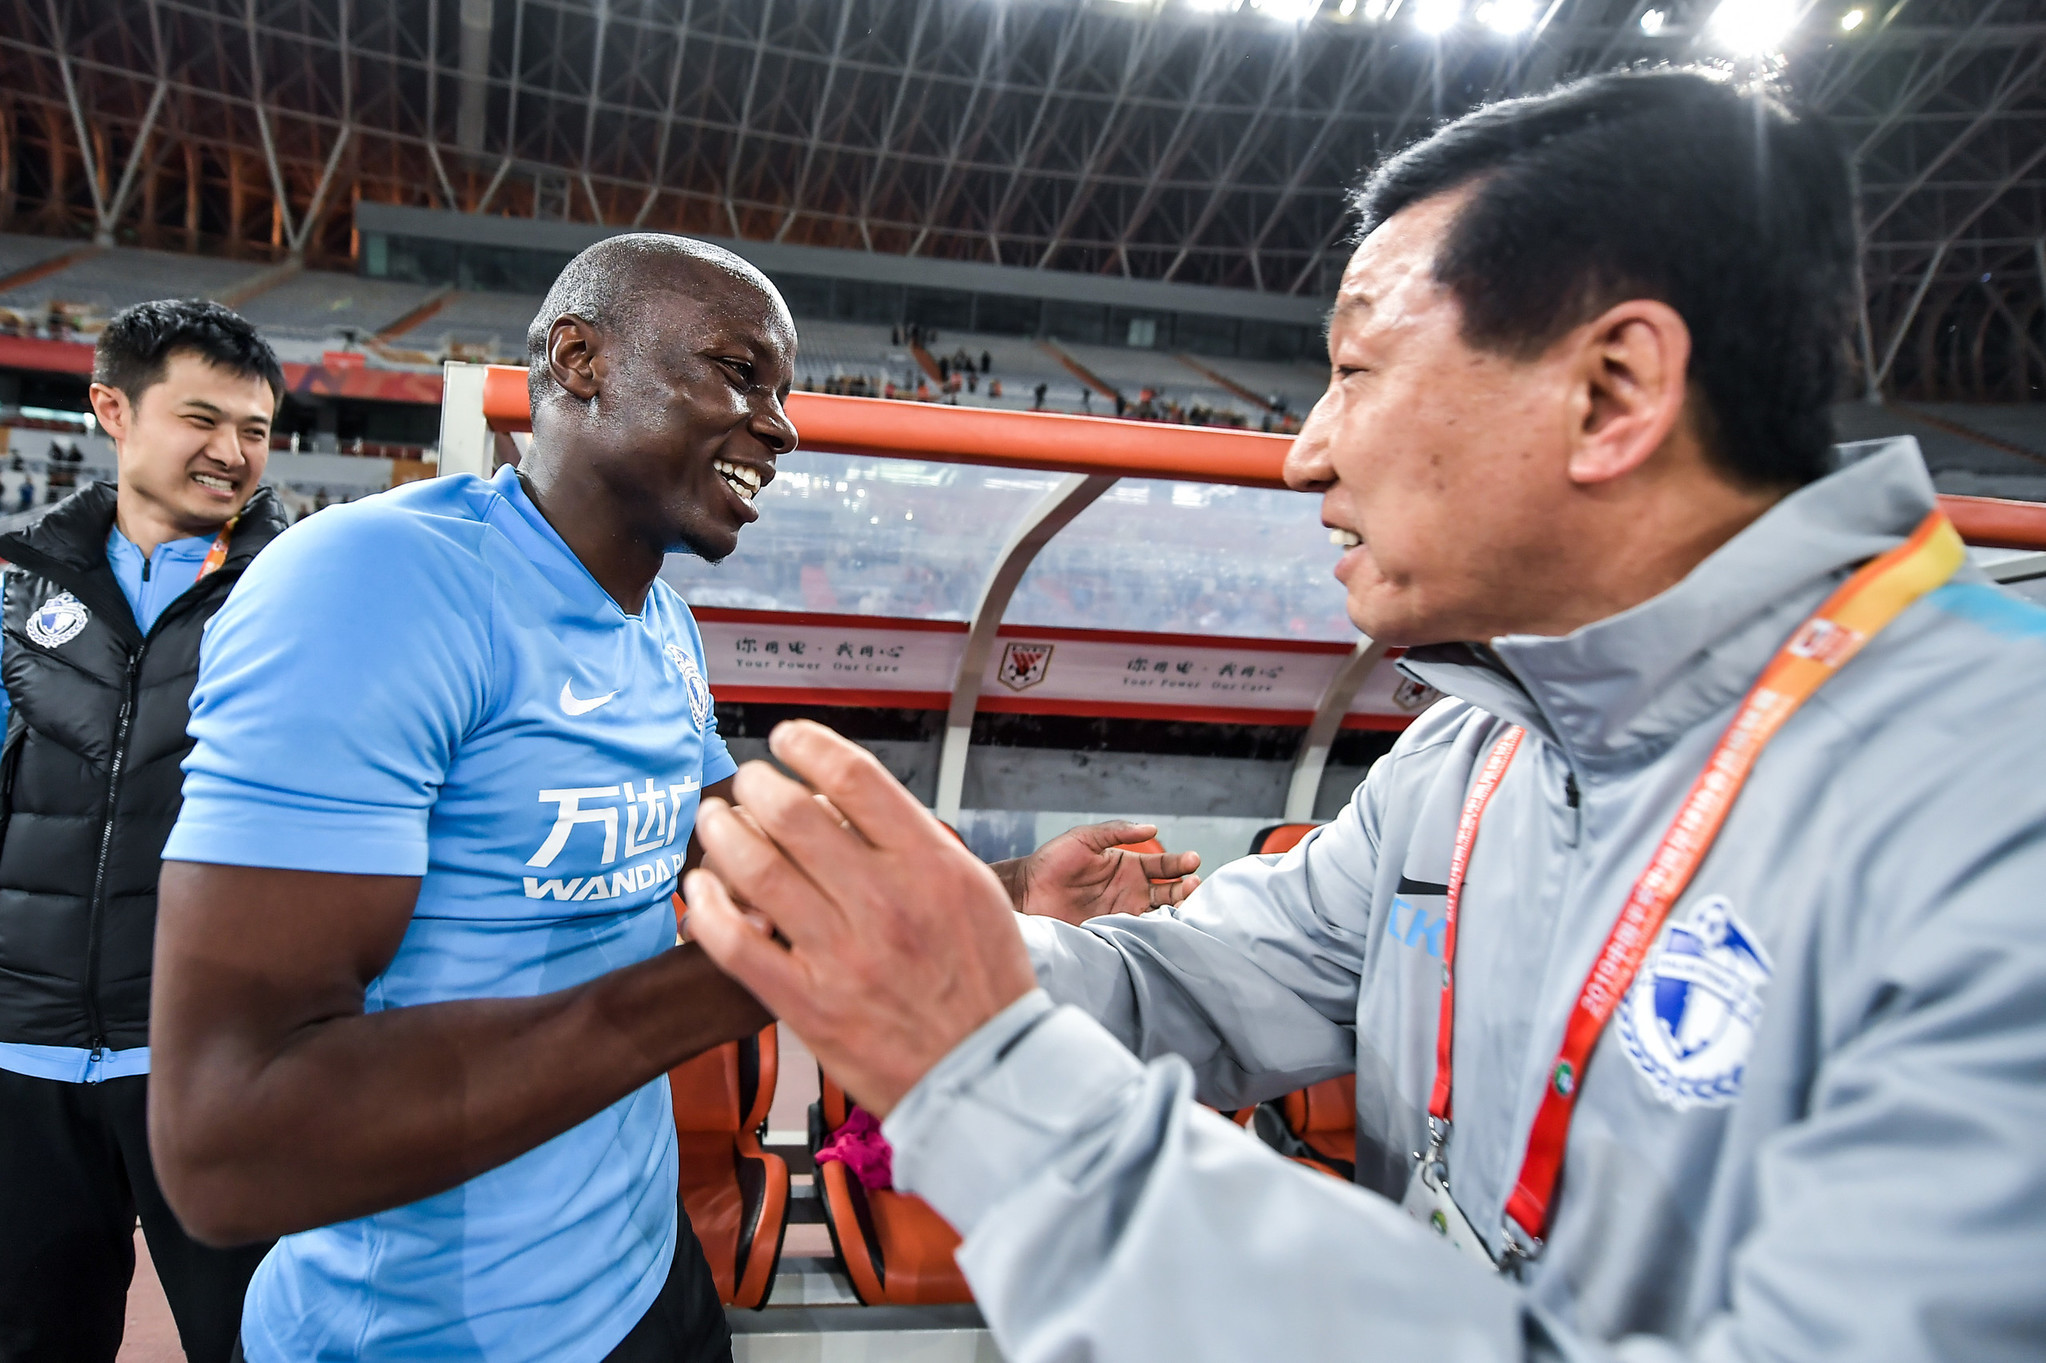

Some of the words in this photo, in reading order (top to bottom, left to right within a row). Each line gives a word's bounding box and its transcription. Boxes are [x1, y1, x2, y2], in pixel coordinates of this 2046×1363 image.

[736, 659, 770, 668] Your
[778, 660, 820, 671] Power
[833, 662, 859, 672] Our
[865, 664, 899, 673] Care
[525, 771, 703, 868] 万达广
[523, 858, 672, 901] WANDA
